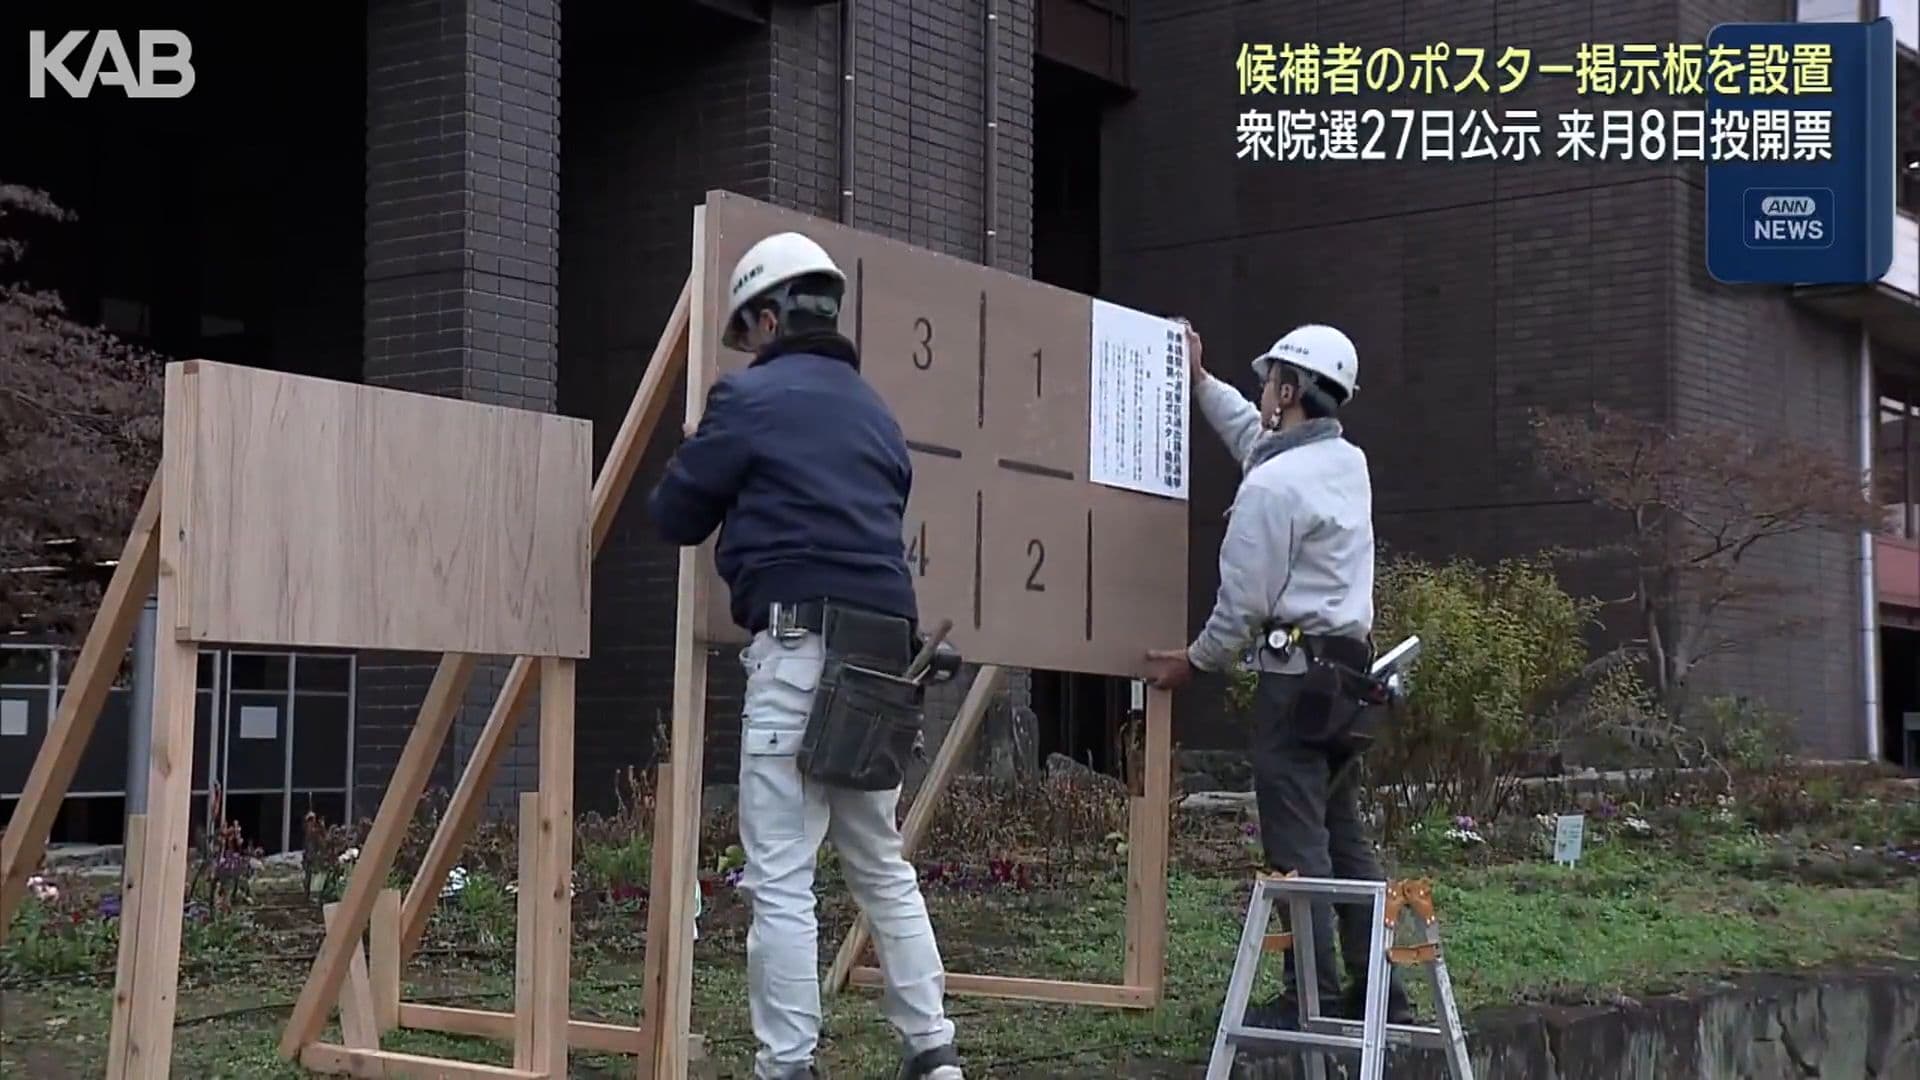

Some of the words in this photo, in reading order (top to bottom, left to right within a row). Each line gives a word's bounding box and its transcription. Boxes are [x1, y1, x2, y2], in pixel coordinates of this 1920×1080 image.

[913, 317, 933, 371] 3
[1032, 348, 1042, 398] 1
[907, 521, 930, 577] 4
[1025, 538, 1046, 592] 2
